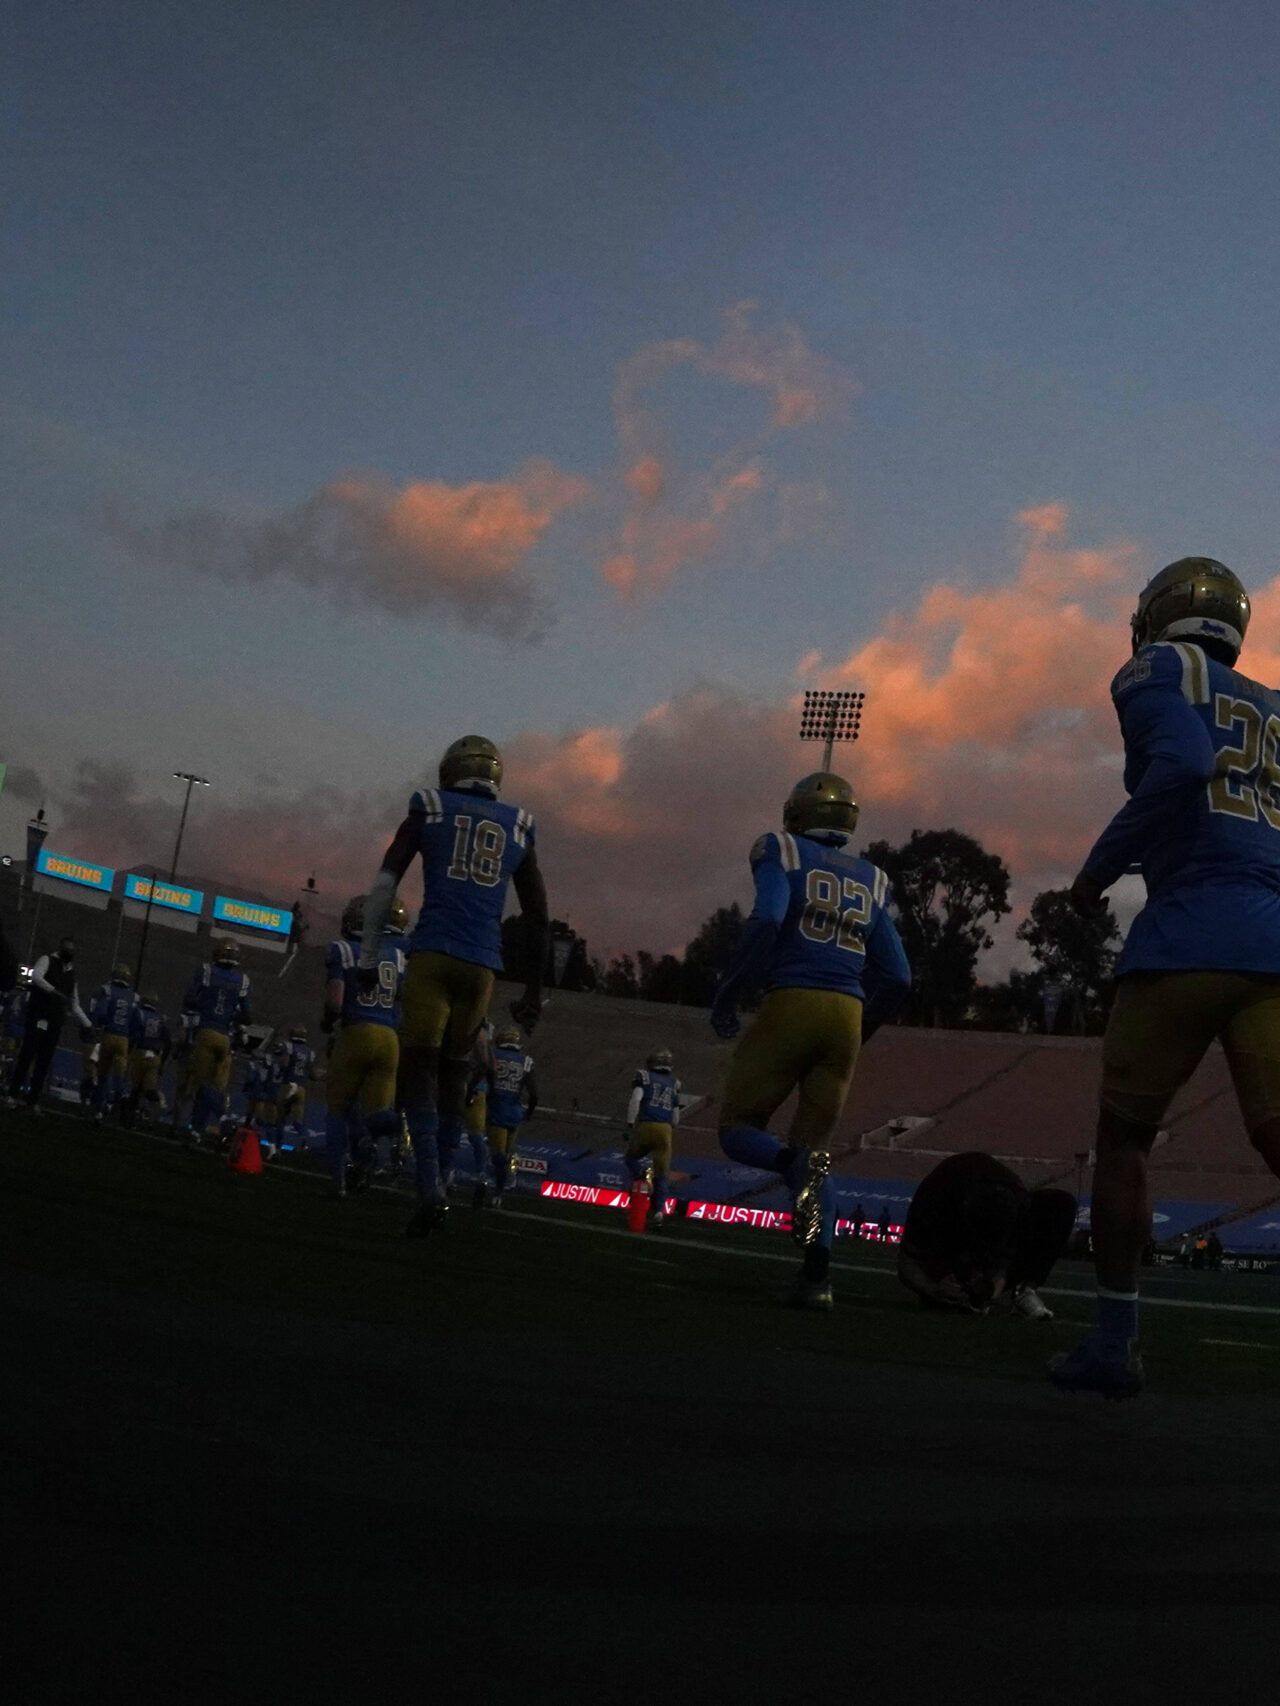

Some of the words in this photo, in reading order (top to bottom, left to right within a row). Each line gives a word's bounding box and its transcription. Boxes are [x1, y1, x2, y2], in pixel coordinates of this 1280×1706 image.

[447, 814, 507, 888] 18
[46, 857, 103, 884] BRUINS
[134, 881, 192, 908] BRUINS
[222, 902, 281, 928] BRUINS
[800, 868, 873, 956] 82
[598, 1172, 624, 1185] TCL
[552, 1183, 600, 1203] JUSTIN
[708, 1203, 784, 1229] JUSTIN
